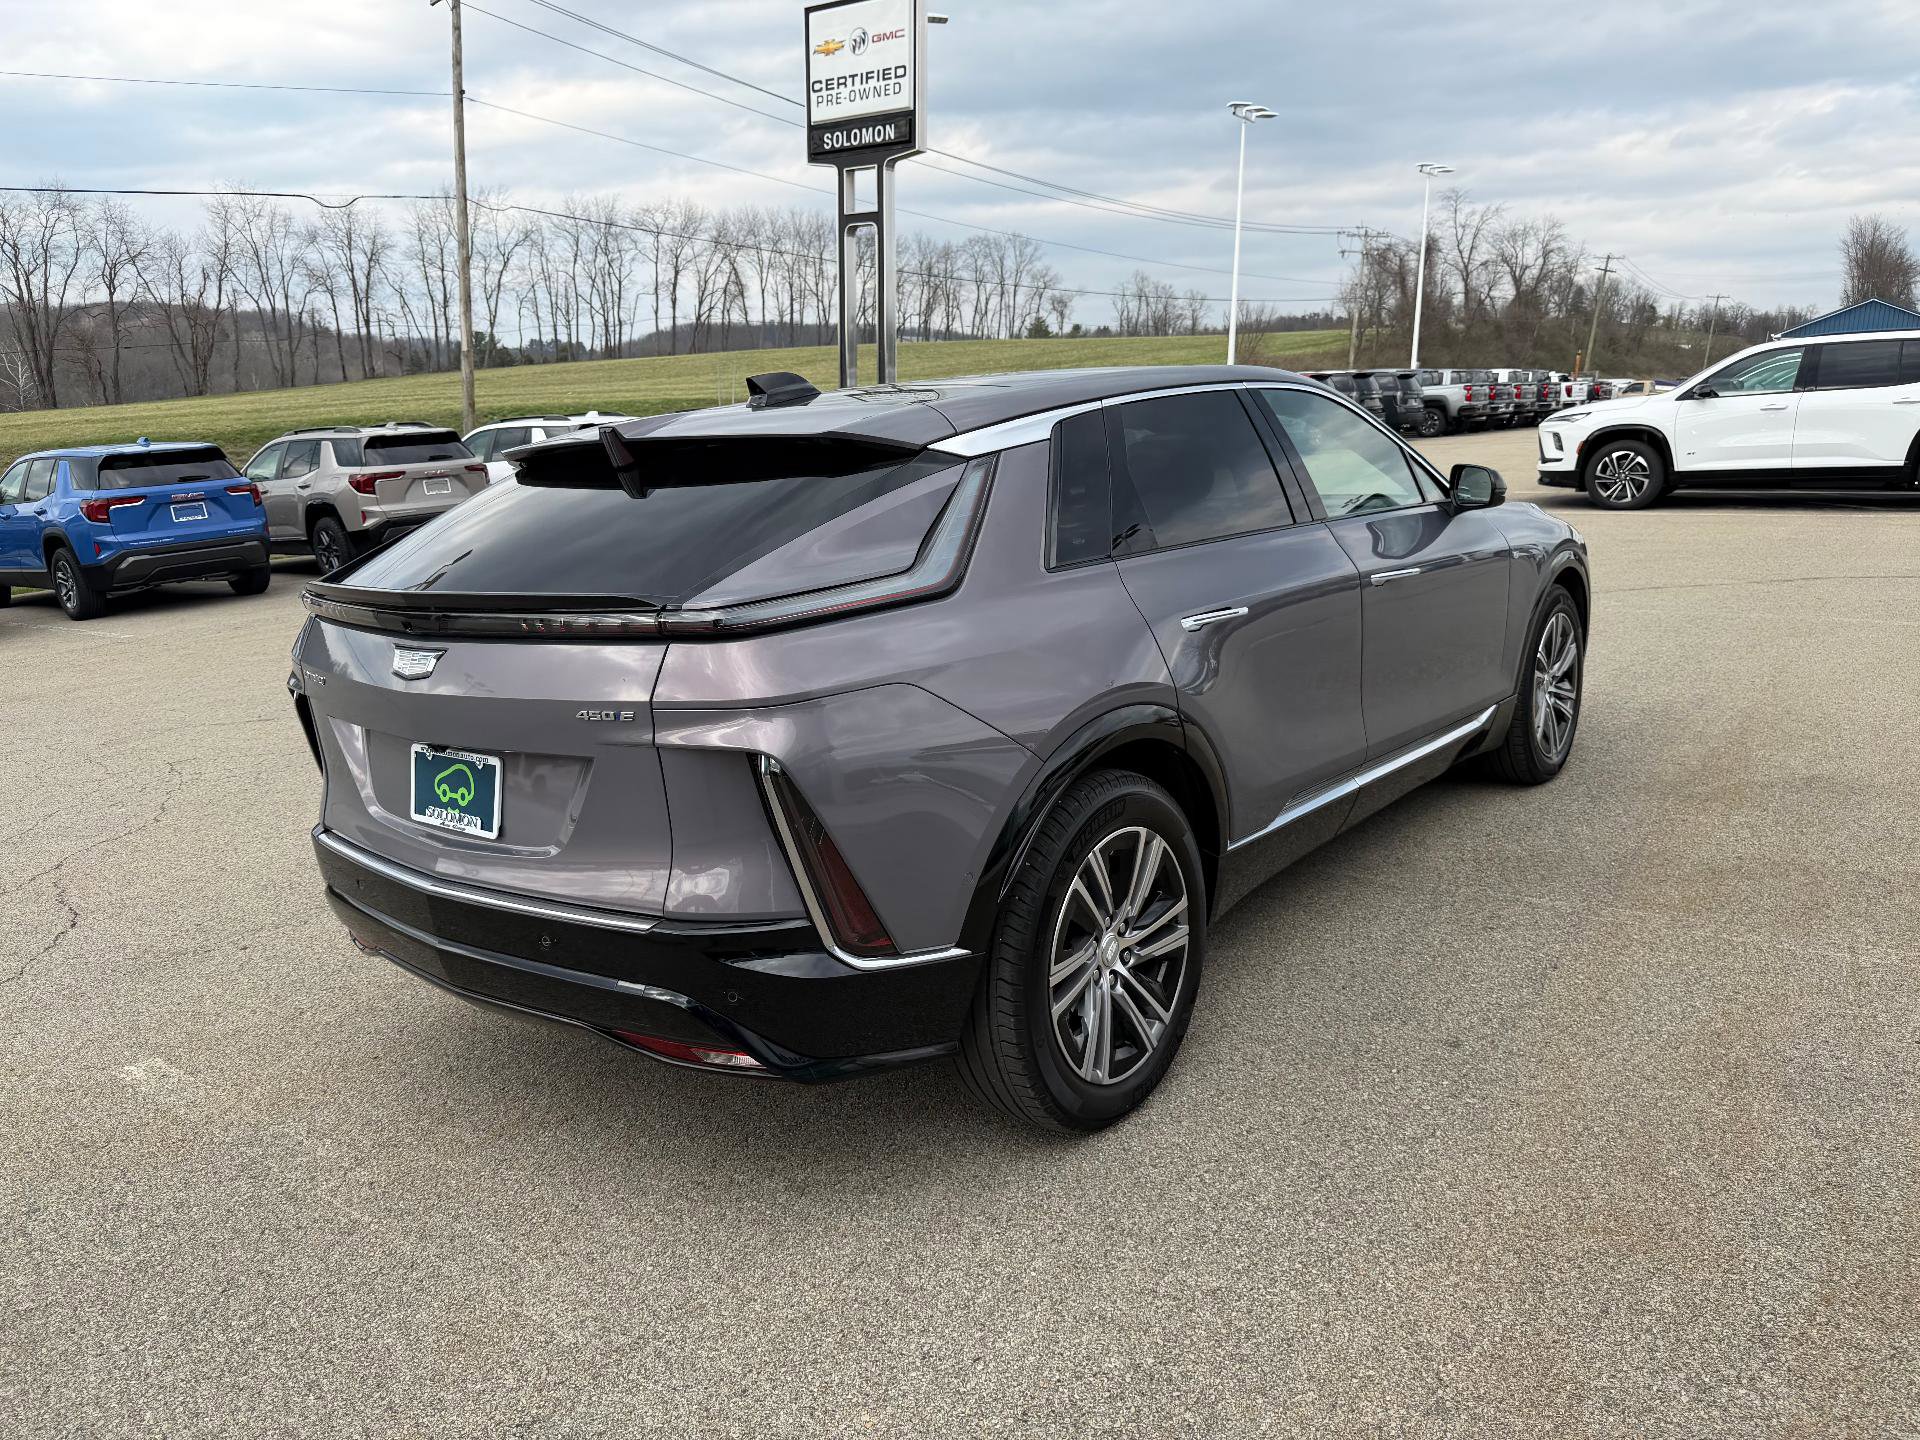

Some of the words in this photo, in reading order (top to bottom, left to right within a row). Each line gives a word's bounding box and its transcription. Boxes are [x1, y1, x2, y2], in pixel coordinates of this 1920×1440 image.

[871, 29, 905, 44] GMC
[811, 64, 907, 93] CERTIFIED
[816, 82, 902, 108] PRE-OWNED
[823, 123, 895, 149] SOLOMON
